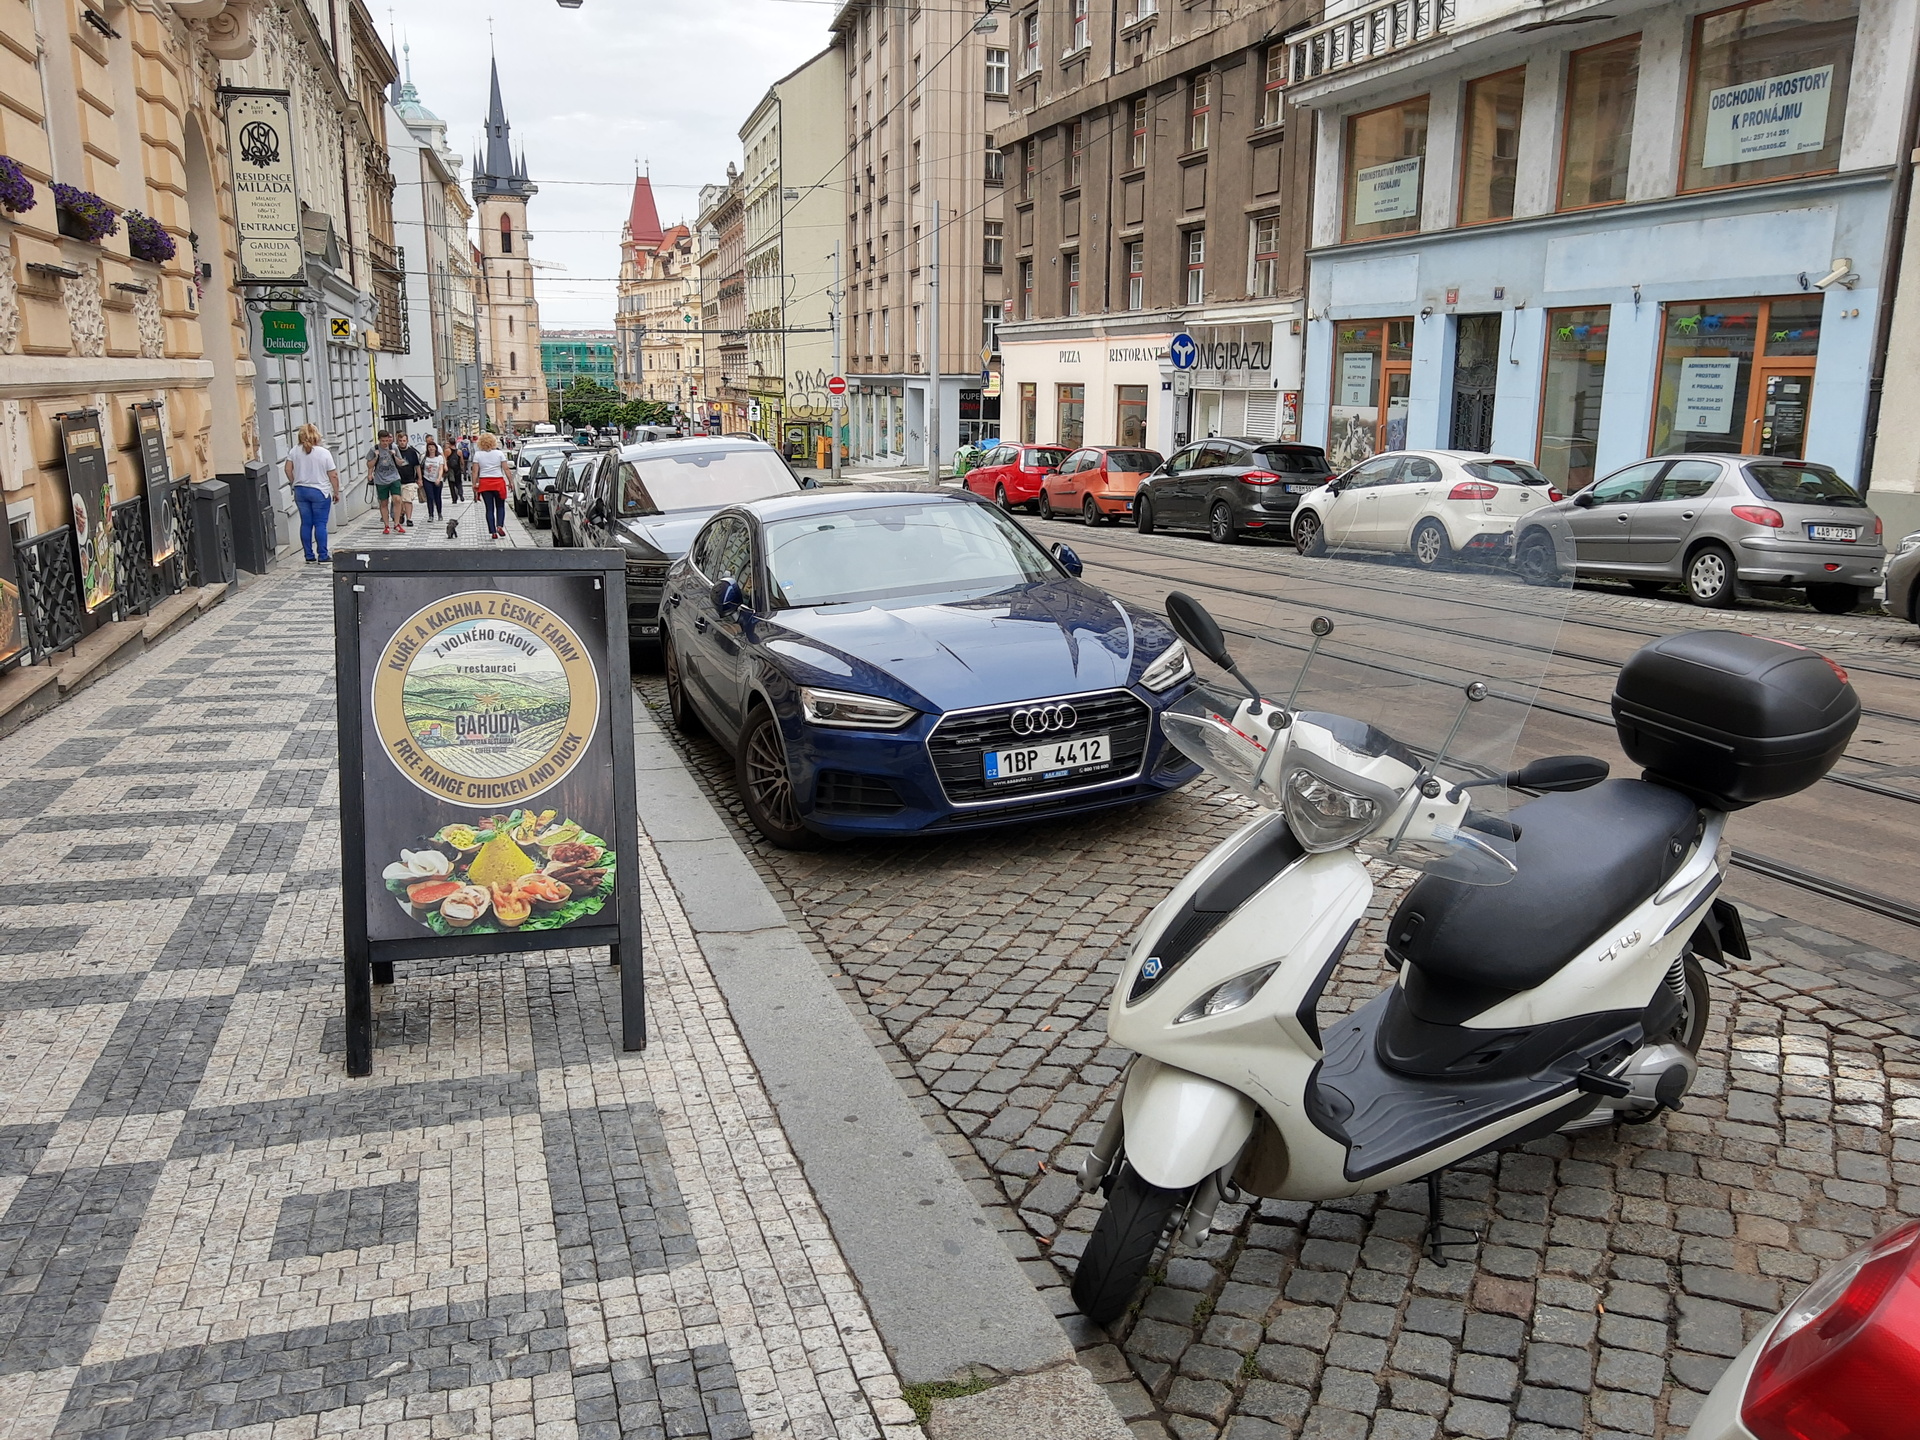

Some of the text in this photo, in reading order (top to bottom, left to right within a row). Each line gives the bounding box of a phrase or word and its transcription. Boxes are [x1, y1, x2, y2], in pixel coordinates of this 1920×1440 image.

[1712, 71, 1830, 110] OBCHODNÍ PROSTORY
[1732, 102, 1802, 130] K PRONÁJMU
[1742, 142, 1786, 154] www.naxos.cz
[236, 173, 291, 182] RESIDENCE
[237, 183, 292, 193] MILADA
[241, 223, 296, 232] ENTRANCE
[250, 242, 290, 250] GARUDA
[266, 337, 306, 351] Delikatesy
[1060, 351, 1080, 362] PIZZA
[1836, 528, 1852, 538] 2759
[388, 598, 580, 671] KUŘE A KACHNA Z ČESKÉ FARMY
[433, 627, 538, 659] Z VOLNÉHO CHOVU
[465, 663, 516, 673] restauraci
[455, 714, 521, 735] GARUDA
[1004, 740, 1101, 773] 1BP 4412
[393, 732, 582, 798] FREE-RANGE CHICKEN AND DUCK
